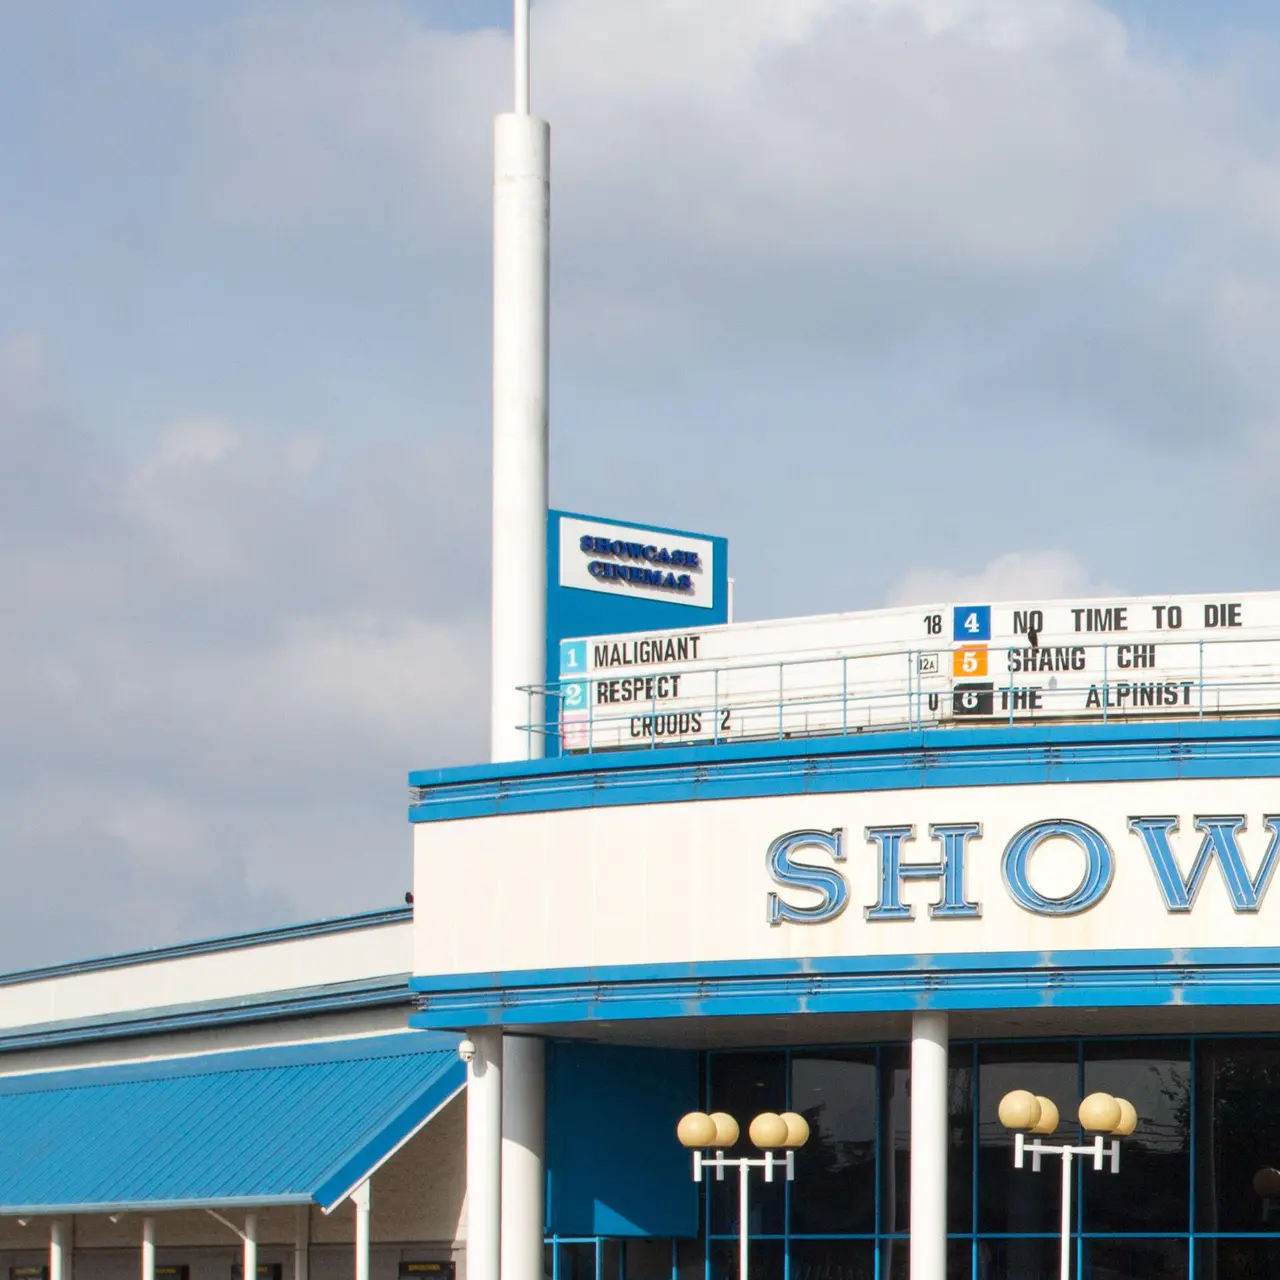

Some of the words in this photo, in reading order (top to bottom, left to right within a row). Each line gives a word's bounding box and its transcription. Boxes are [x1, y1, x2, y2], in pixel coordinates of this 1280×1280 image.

[579, 535, 700, 568] SHOWCASE
[587, 561, 693, 590] CINEMAS
[924, 615, 942, 635] 18
[964, 613, 979, 633] 4
[1013, 610, 1043, 634] NO
[1071, 608, 1128, 632] TIME
[1152, 605, 1182, 629] TO
[1204, 604, 1242, 628] DIE
[566, 649, 579, 667] 1
[594, 637, 700, 668] MALIGNANT
[963, 652, 977, 673] 5
[1008, 647, 1086, 673] SHANG
[1117, 645, 1156, 668] CHI
[565, 685, 582, 706] 2
[597, 676, 681, 704] RESPECT
[962, 689, 978, 708] 6
[999, 687, 1043, 710] THE
[1086, 682, 1194, 708] ALPINIST
[630, 710, 701, 737] CROODS
[720, 710, 732, 732] 2
